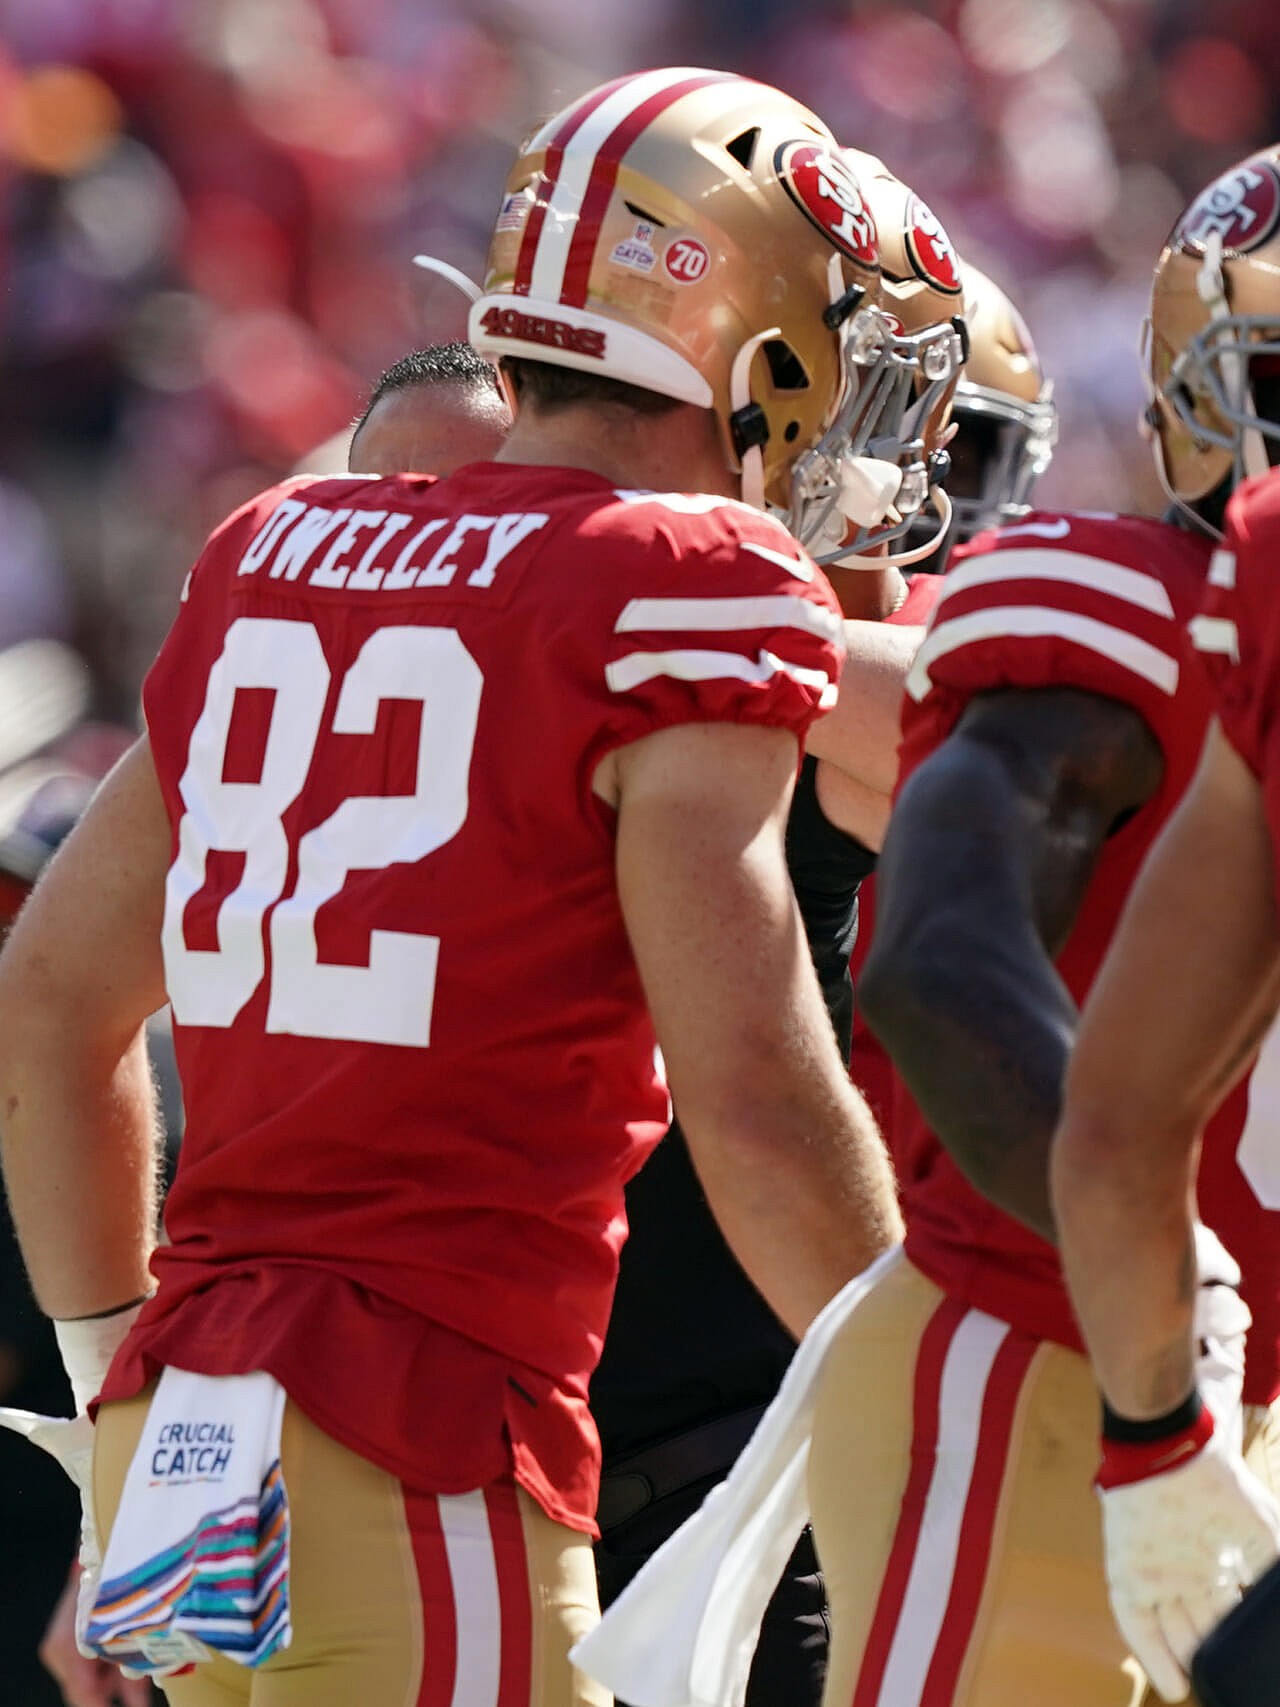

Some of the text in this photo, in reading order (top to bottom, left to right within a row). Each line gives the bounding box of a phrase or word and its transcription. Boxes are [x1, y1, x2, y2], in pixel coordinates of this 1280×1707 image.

[669, 243, 706, 278] 70
[479, 306, 606, 360] 49ERS
[238, 500, 551, 591] DWELLEY
[162, 617, 484, 1048] 82
[158, 1423, 235, 1444] CRUCIAL
[152, 1447, 232, 1475] CATCH
